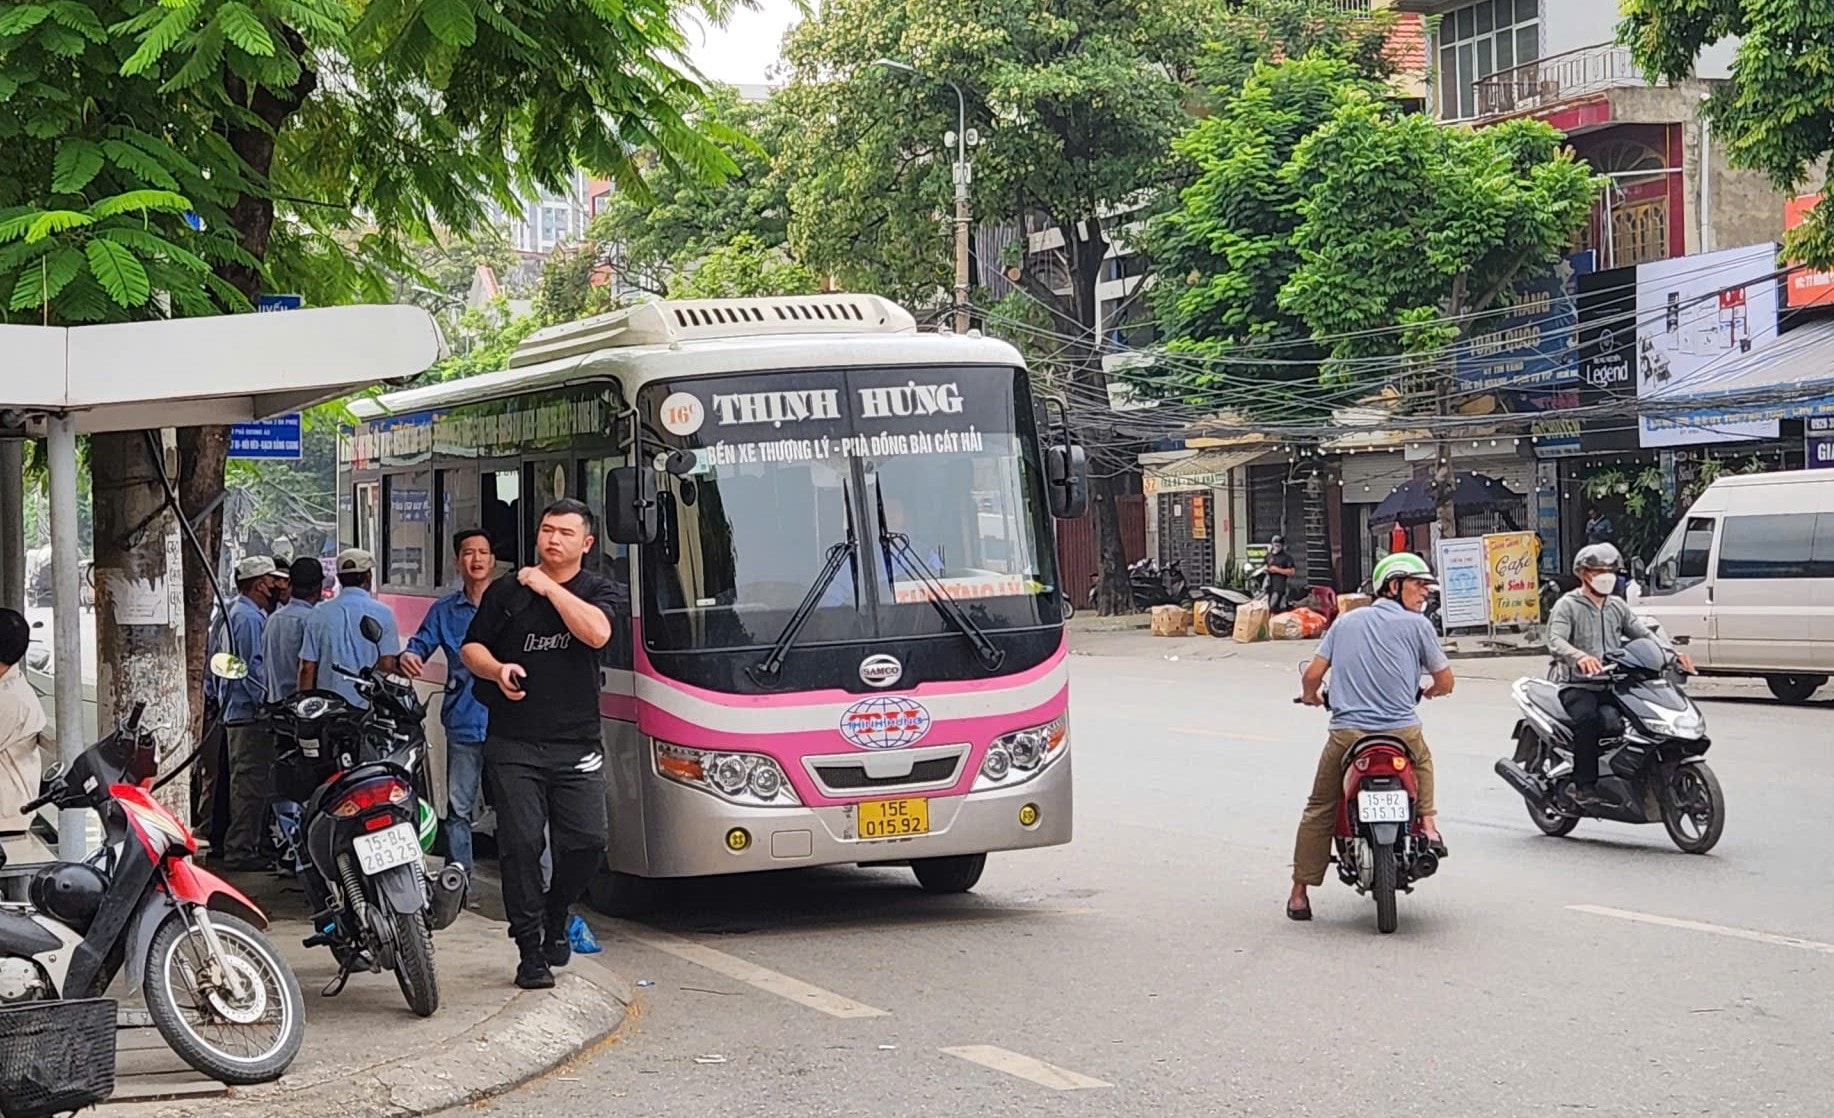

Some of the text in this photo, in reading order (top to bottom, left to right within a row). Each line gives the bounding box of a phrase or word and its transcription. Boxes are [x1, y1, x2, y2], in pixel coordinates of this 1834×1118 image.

[1587, 360, 1628, 388] Legend
[713, 380, 964, 428] THỊNH HƯNG
[706, 440, 736, 466] BẾN
[738, 443, 757, 464] XE
[758, 436, 812, 464] THƯỢNG
[813, 434, 831, 460] LÝ
[871, 429, 907, 456] ĐỒNG
[909, 429, 933, 453] BÀI
[934, 428, 959, 452] CÁT
[960, 424, 984, 452] HẢI
[863, 666, 899, 676] SAMCO
[880, 801, 908, 818] 15E
[1367, 793, 1399, 806] 15-B2
[866, 818, 921, 836] 015.92
[365, 828, 406, 852] 15-B4
[364, 842, 418, 871] 283.25
